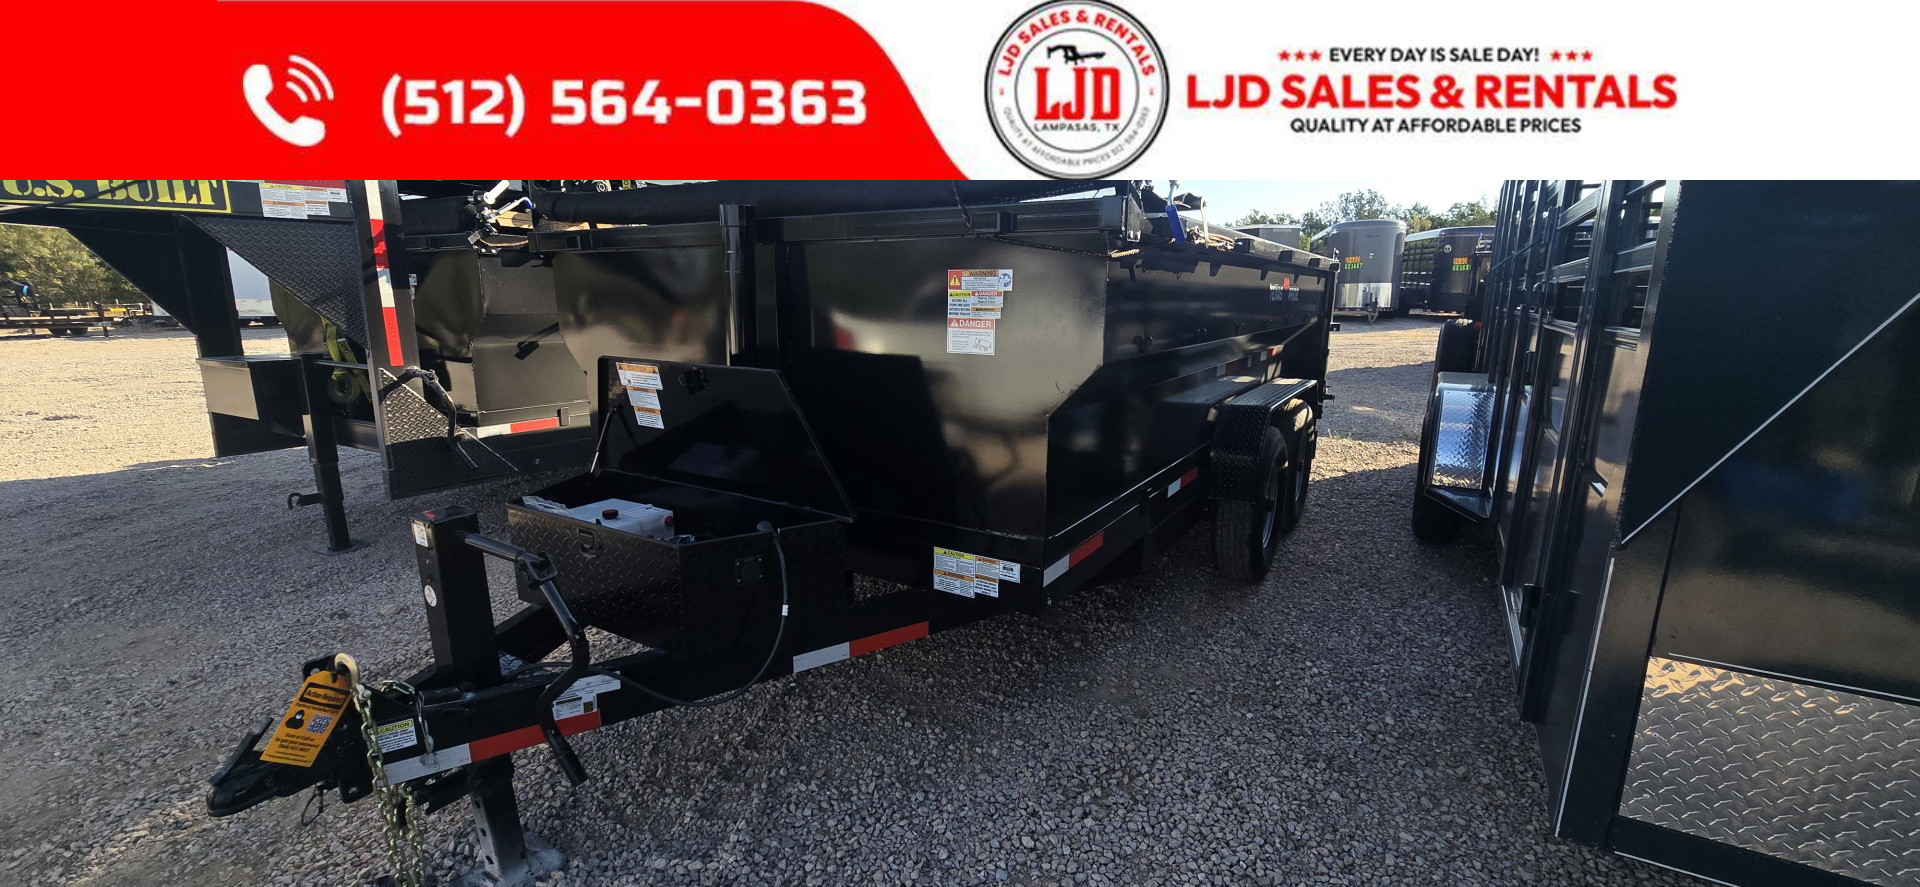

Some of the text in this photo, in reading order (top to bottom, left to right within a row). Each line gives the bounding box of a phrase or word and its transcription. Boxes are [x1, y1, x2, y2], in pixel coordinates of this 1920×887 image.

[960, 319, 991, 328] DANGER
[305, 690, 322, 698] Action
[380, 721, 409, 733] CAUTION
